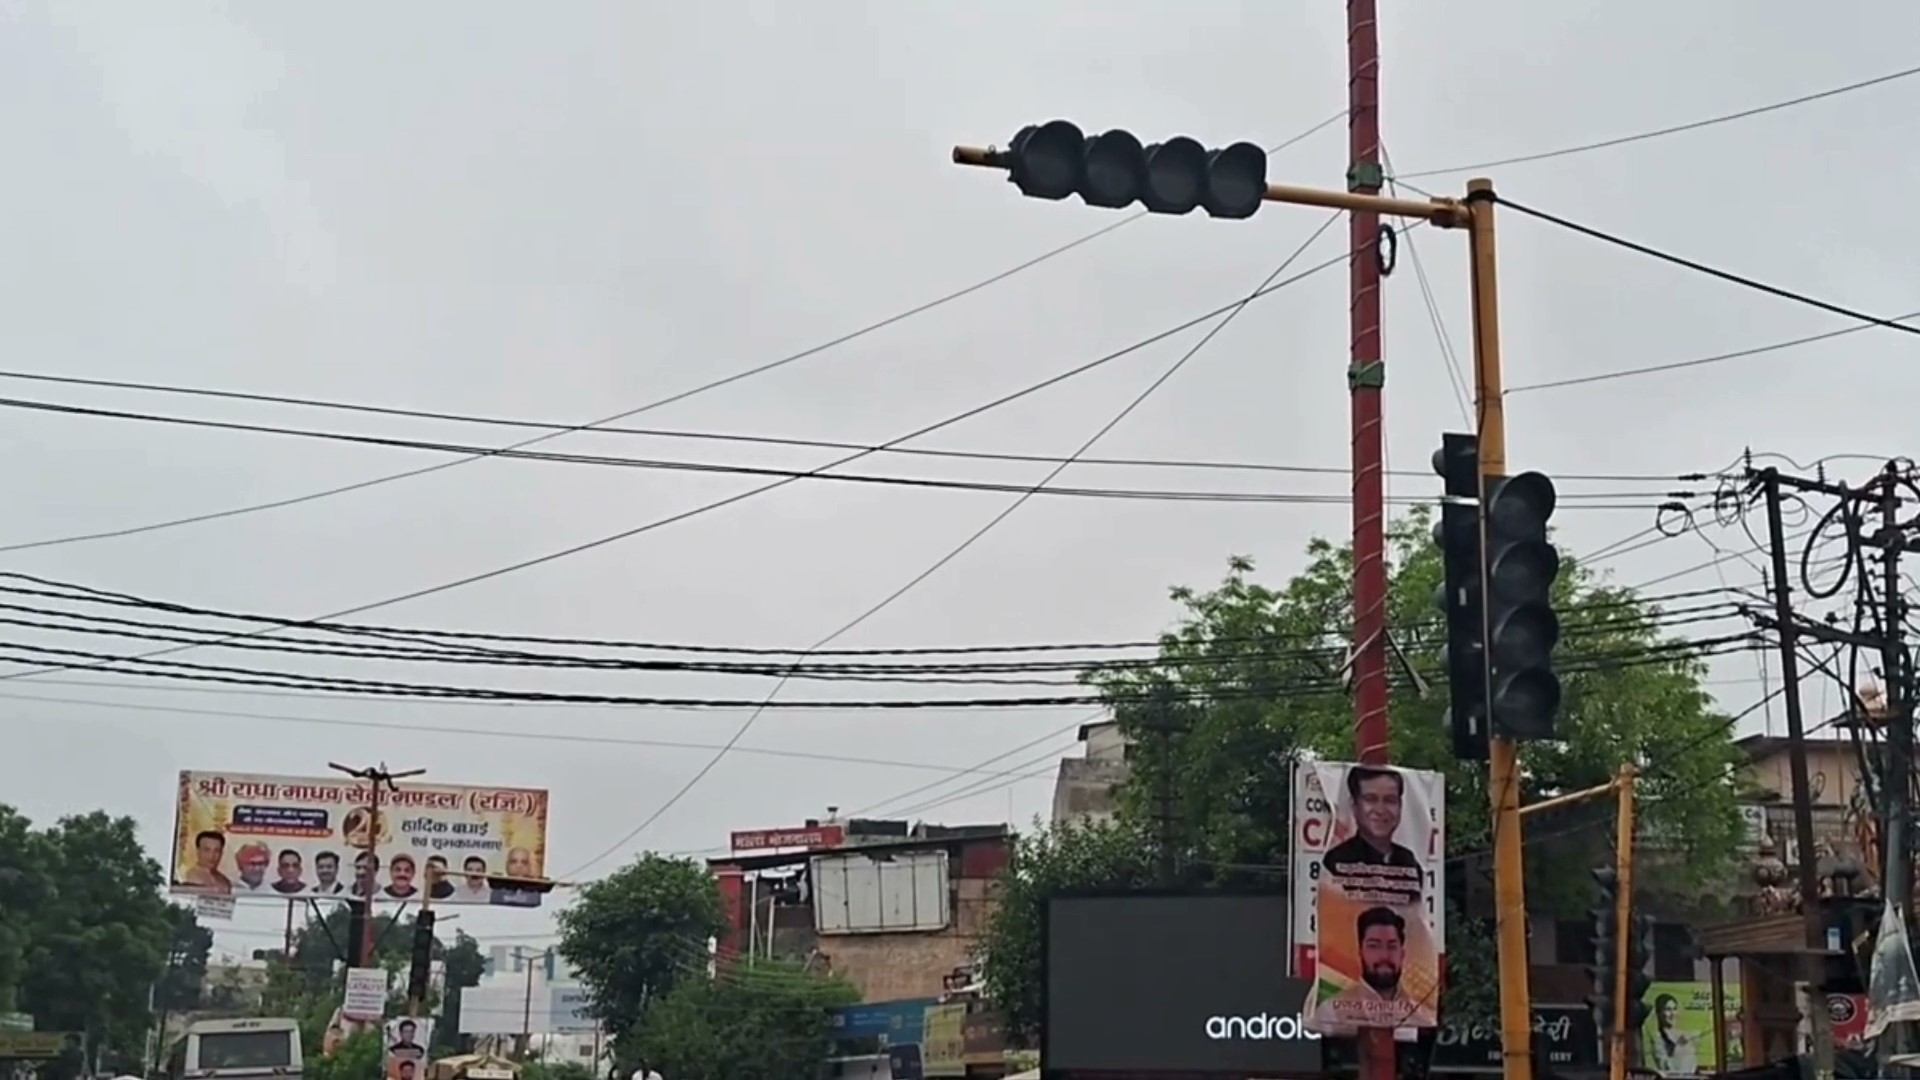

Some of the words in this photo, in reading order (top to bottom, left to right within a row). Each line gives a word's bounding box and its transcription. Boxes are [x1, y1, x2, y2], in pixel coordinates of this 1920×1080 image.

[199, 776, 227, 798] श्री
[231, 781, 278, 799] राधा
[282, 783, 340, 802] माधव
[401, 816, 447, 834] हार्दिक
[451, 819, 489, 837] बधाई
